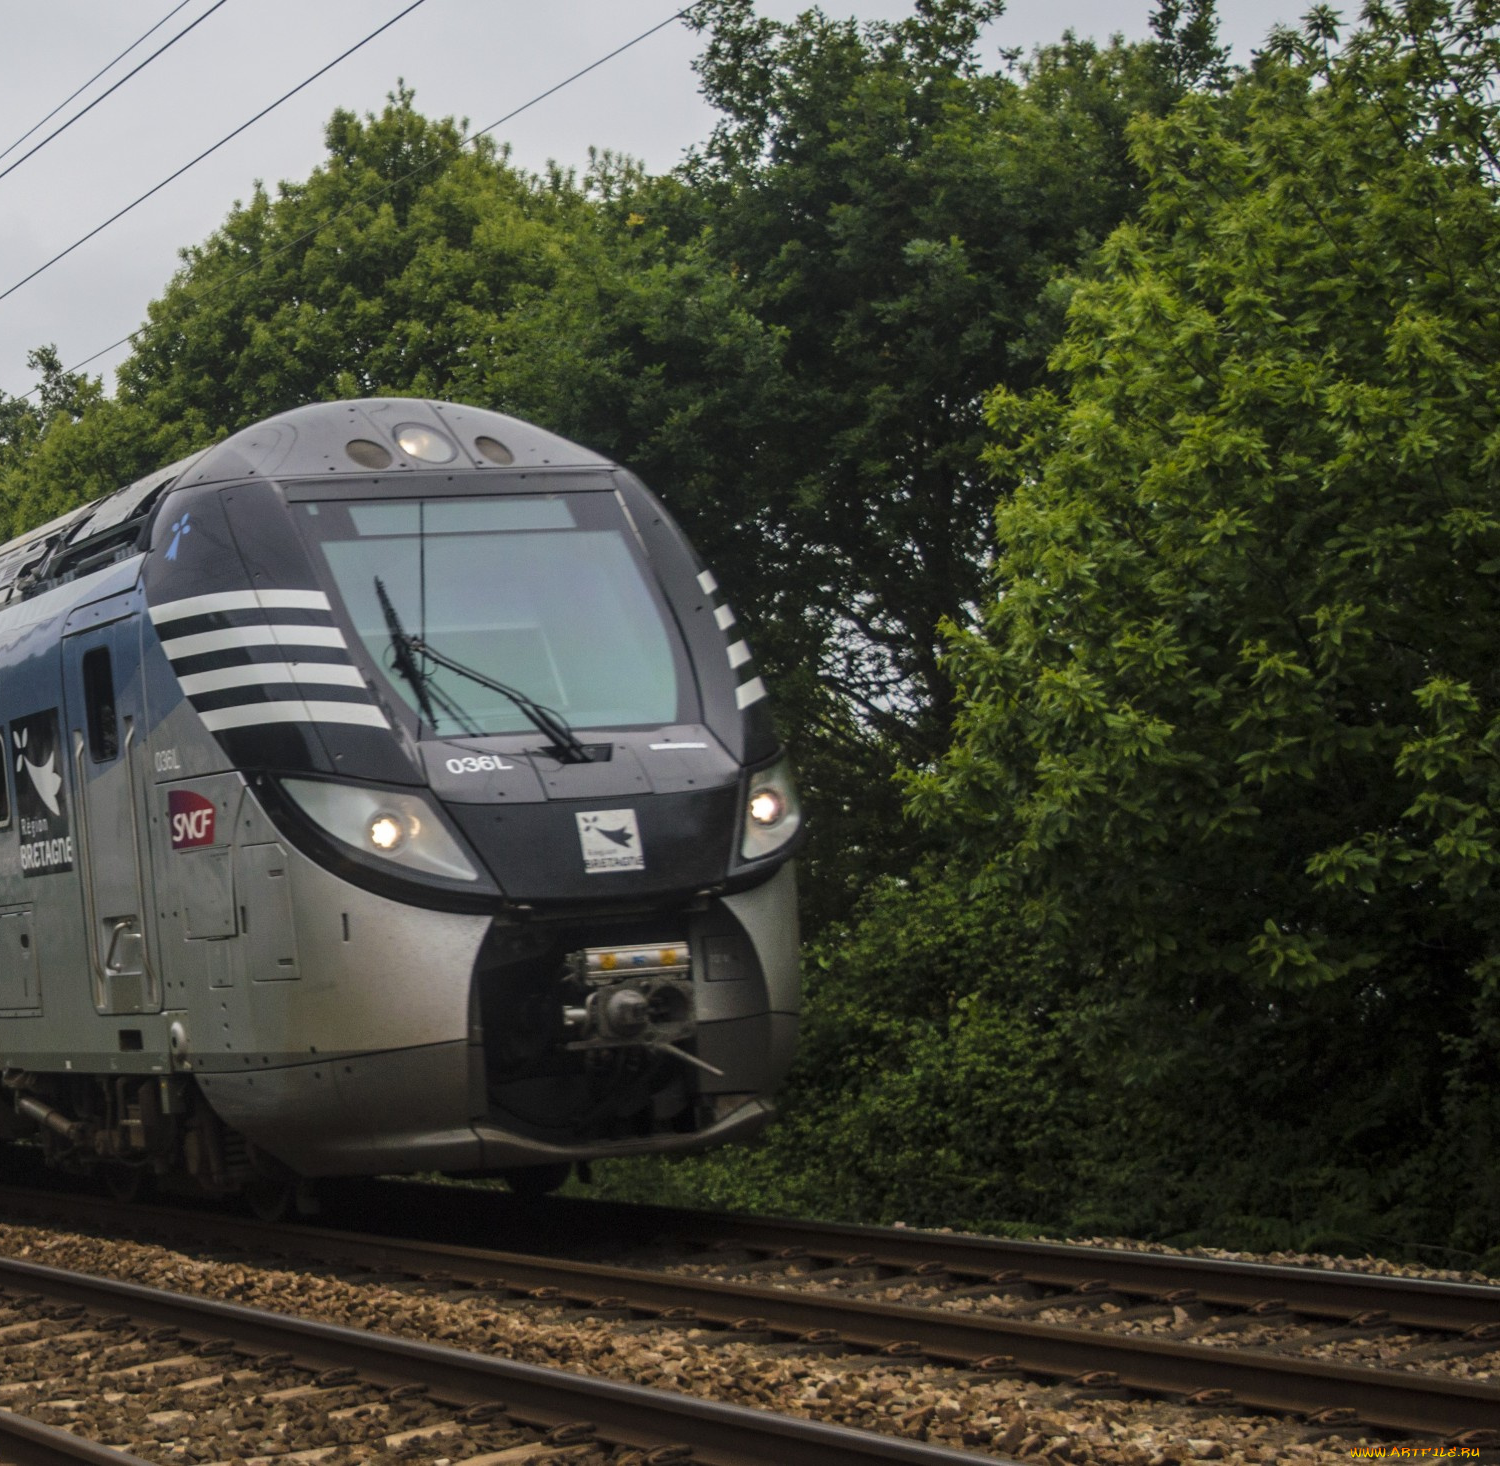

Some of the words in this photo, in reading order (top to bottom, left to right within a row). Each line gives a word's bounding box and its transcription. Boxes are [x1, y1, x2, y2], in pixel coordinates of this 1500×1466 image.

[155, 749, 181, 772] 036L
[446, 755, 514, 775] 036L
[20, 817, 49, 838] Région
[173, 808, 213, 842] SNCF
[20, 836, 73, 870] BRETAGNE
